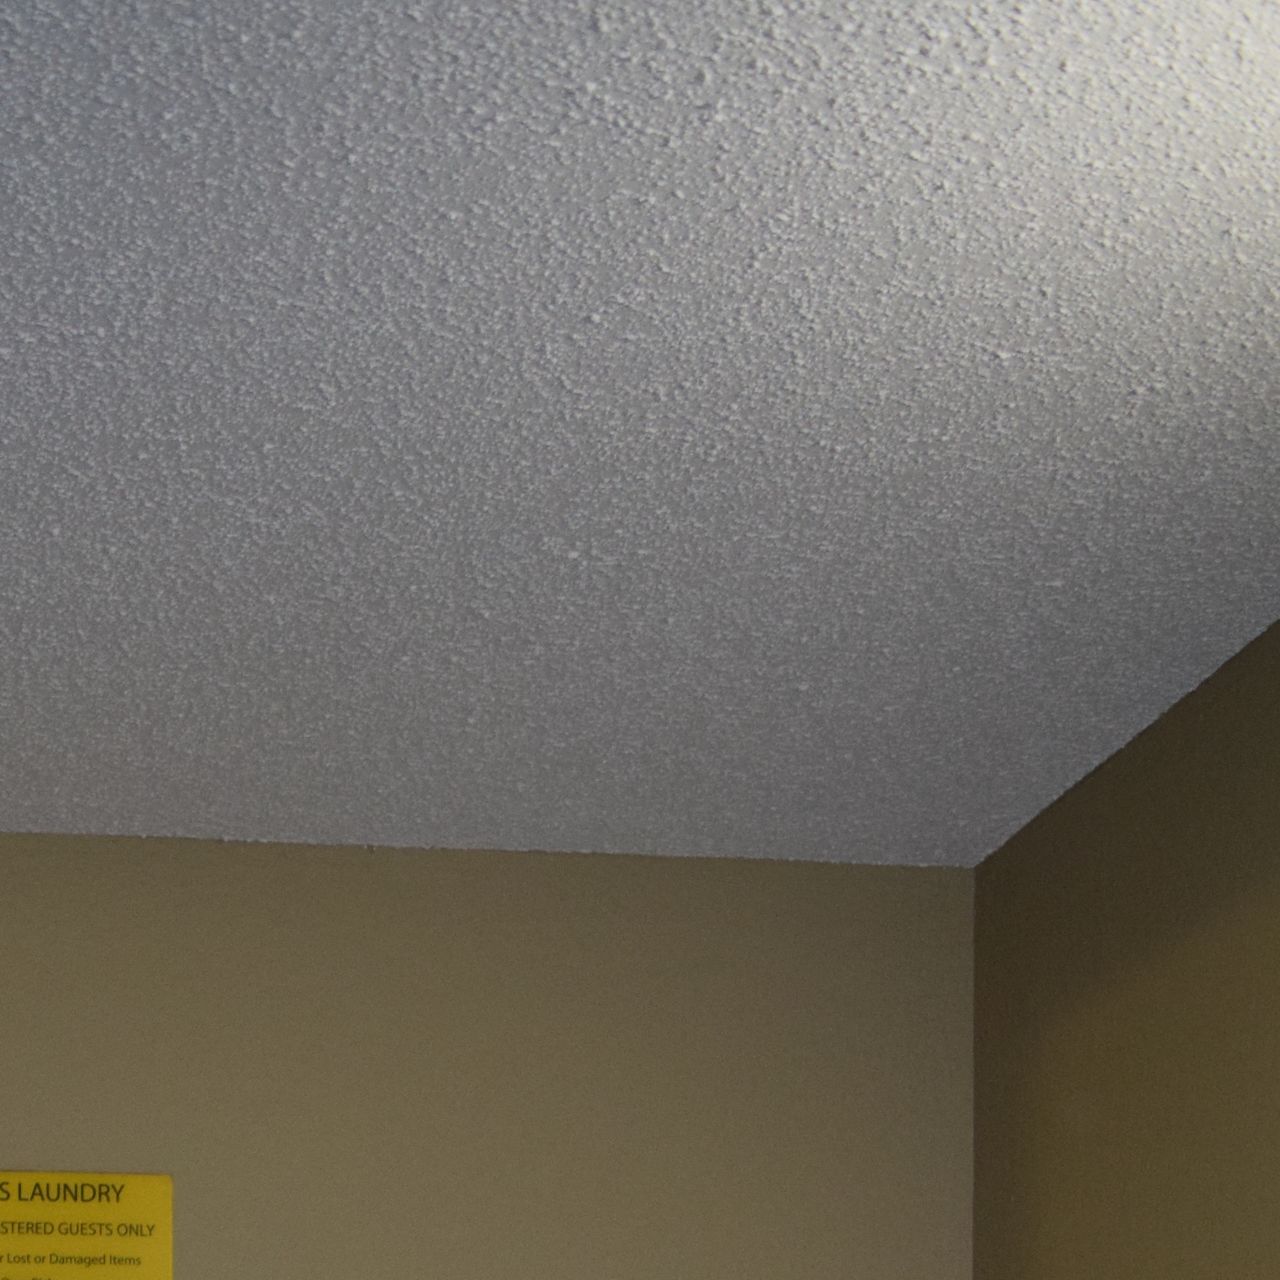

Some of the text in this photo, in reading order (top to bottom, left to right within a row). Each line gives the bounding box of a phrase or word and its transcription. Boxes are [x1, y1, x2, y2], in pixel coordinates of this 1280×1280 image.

[18, 1183, 124, 1203] LAUNDRY
[58, 1222, 113, 1236] GUESTS
[117, 1223, 155, 1237] ONLY
[6, 1253, 32, 1264] Lost
[33, 1255, 47, 1264] or
[48, 1254, 107, 1267] Damaged
[109, 1255, 142, 1265] Items
